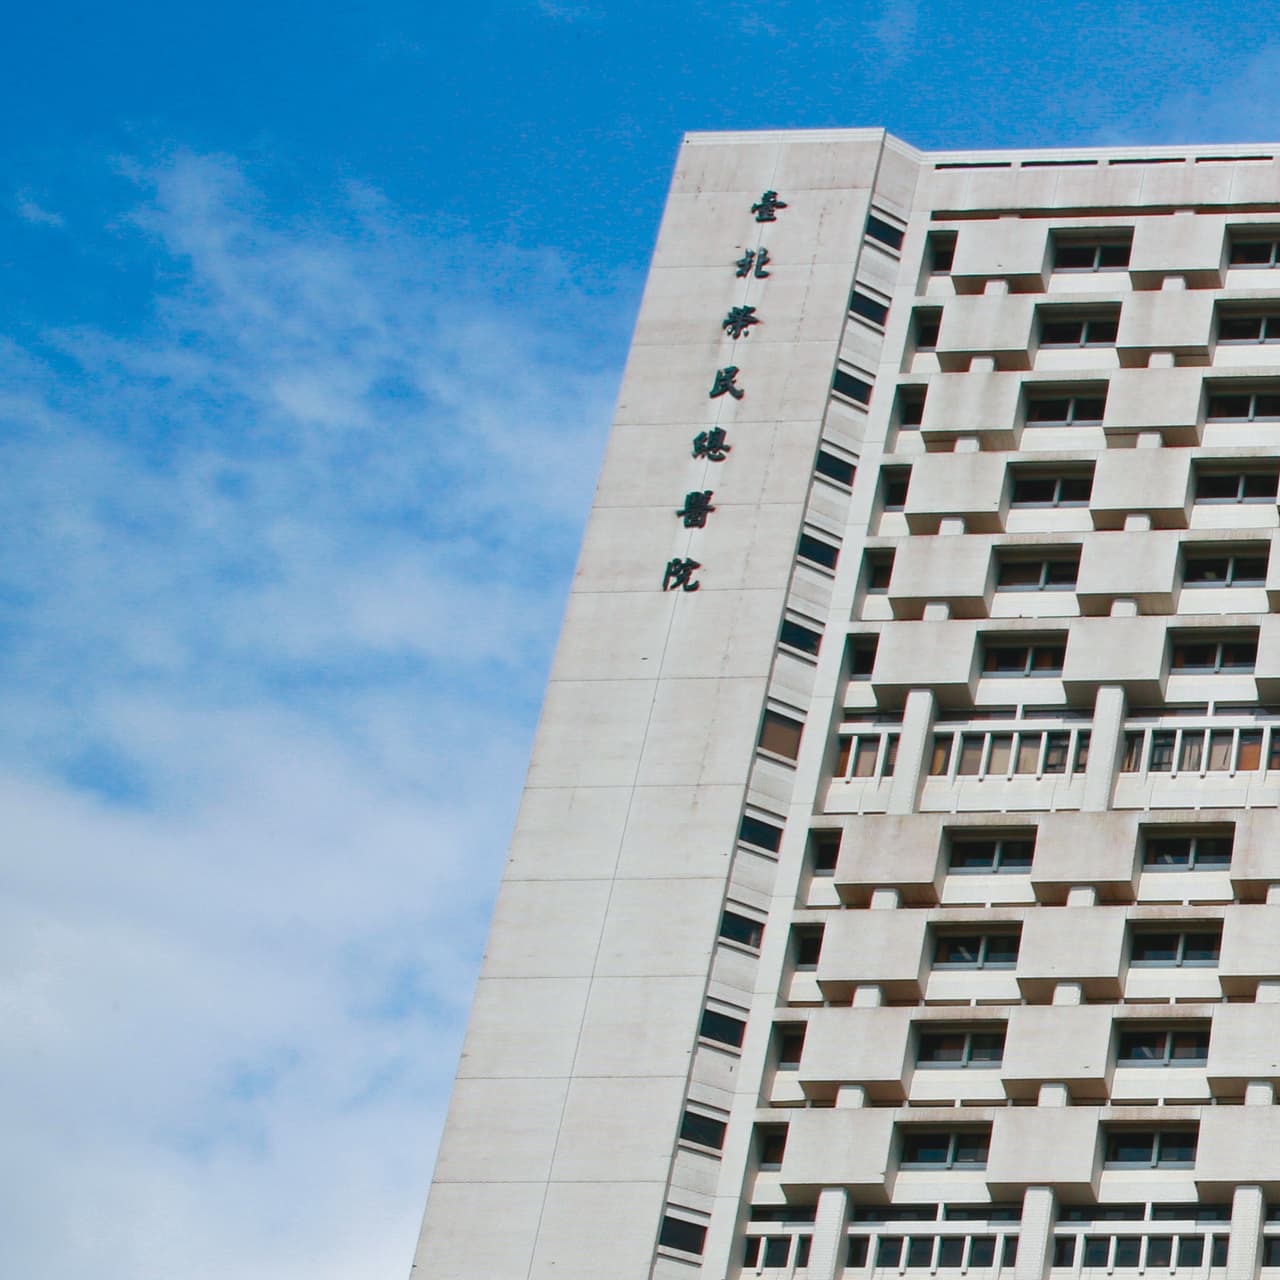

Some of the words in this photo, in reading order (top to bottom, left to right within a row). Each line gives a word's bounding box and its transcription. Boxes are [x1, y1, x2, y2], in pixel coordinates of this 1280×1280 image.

[662, 190, 788, 593] 臺北榮民總醫院
